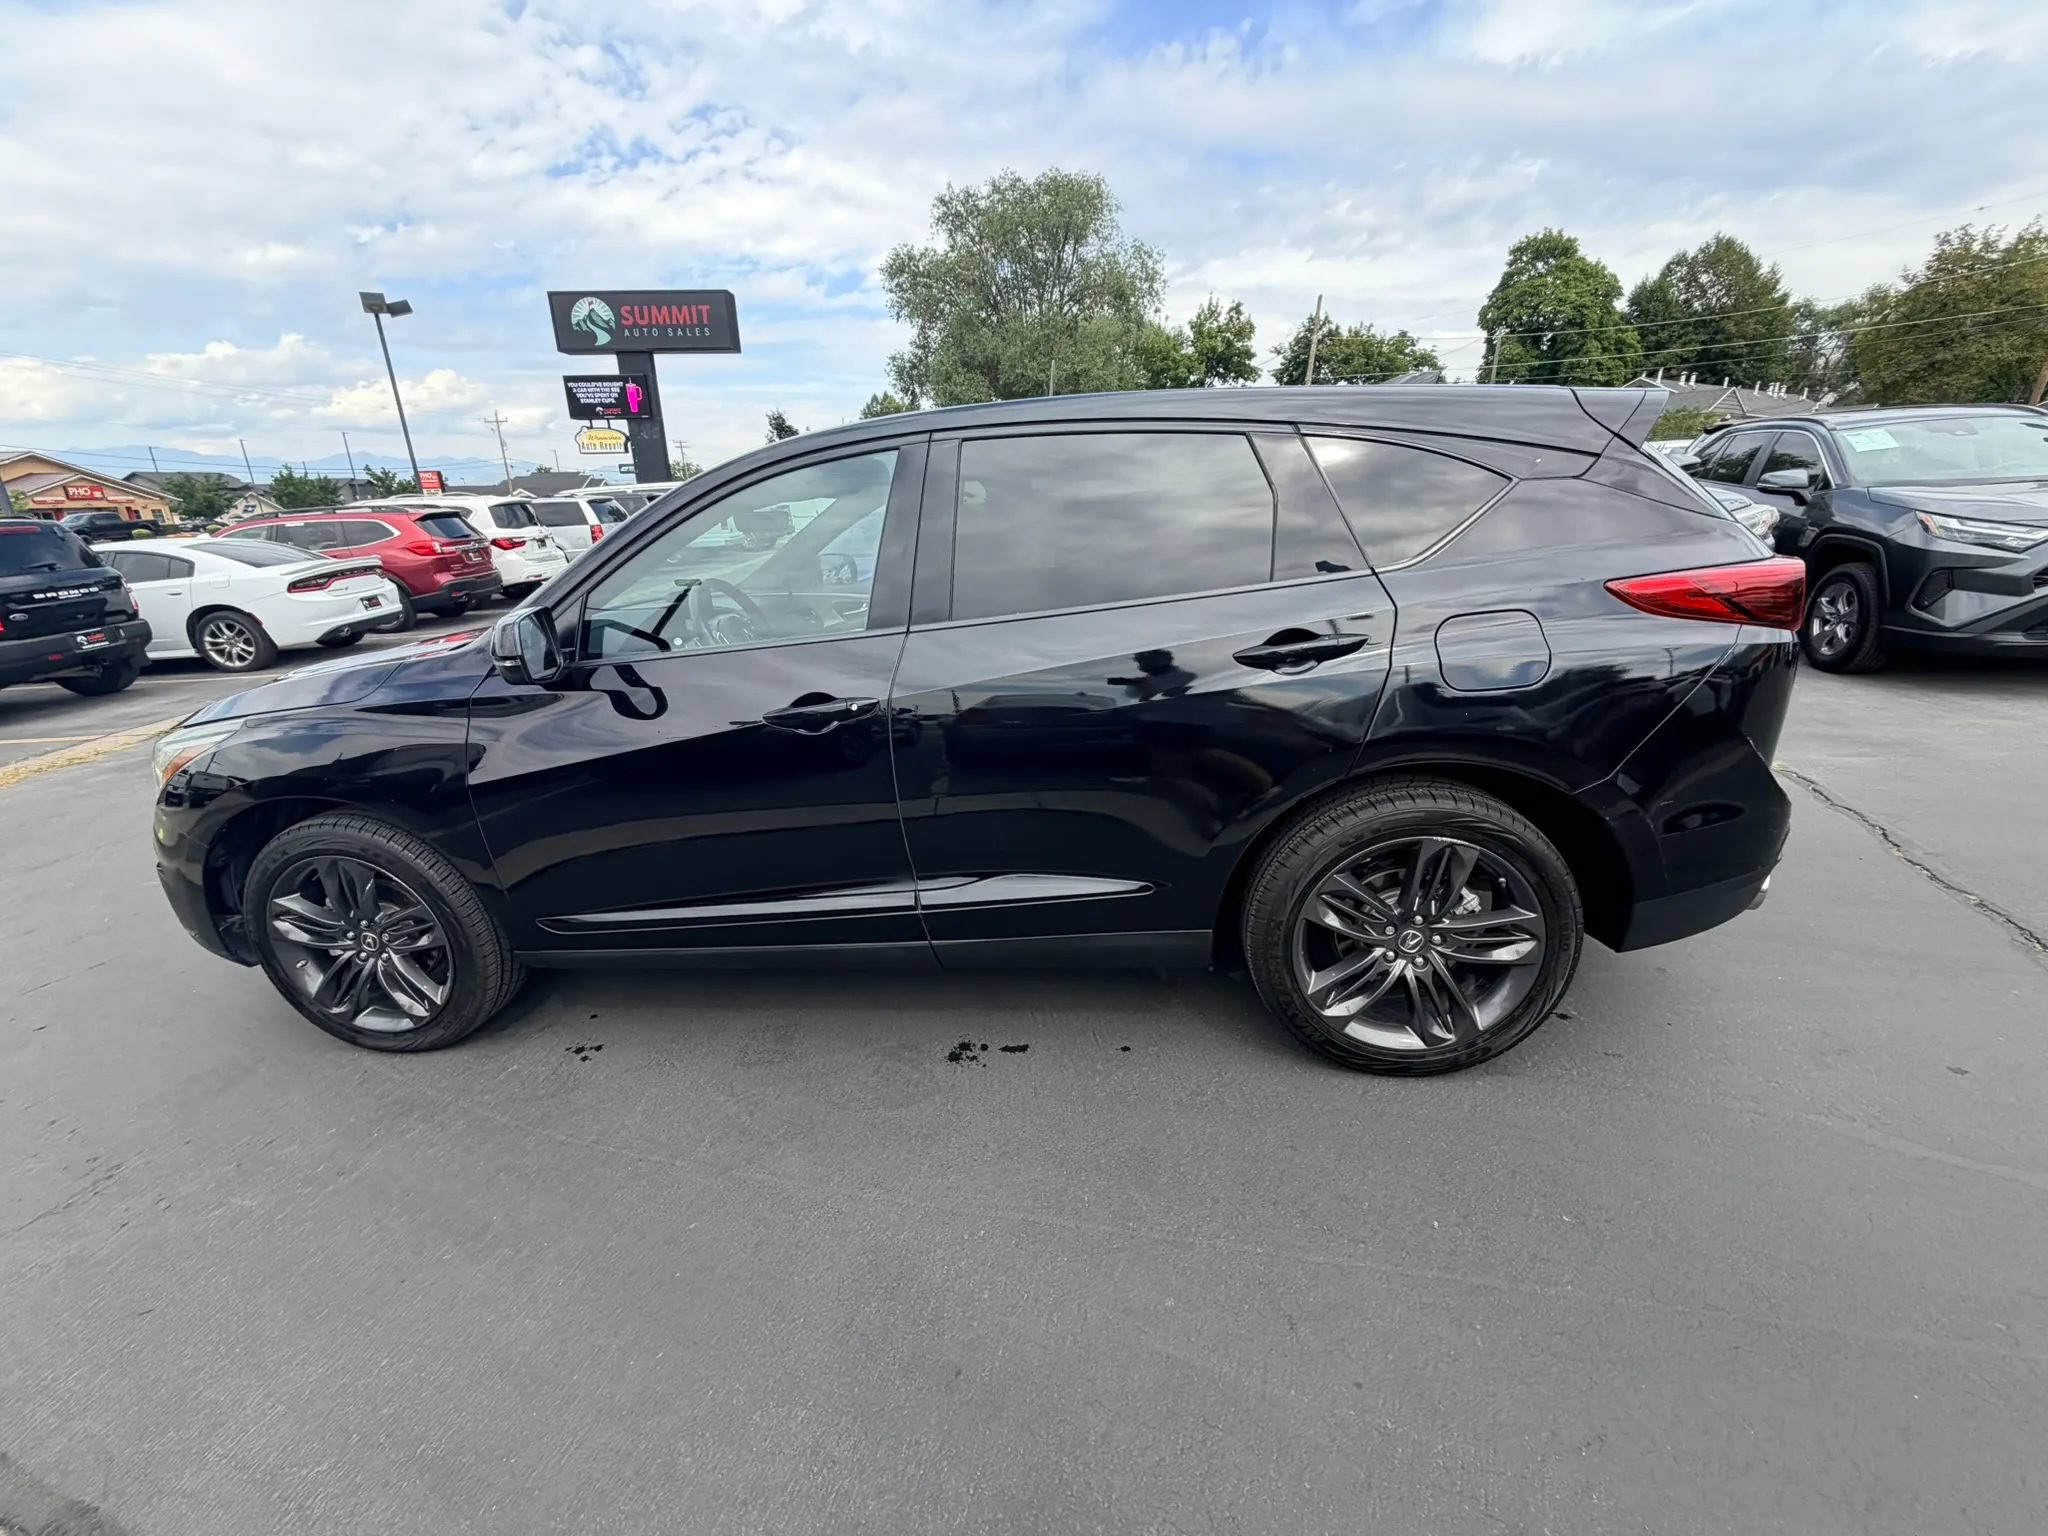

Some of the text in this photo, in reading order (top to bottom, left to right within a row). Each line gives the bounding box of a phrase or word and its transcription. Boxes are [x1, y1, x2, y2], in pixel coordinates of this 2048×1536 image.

[620, 305, 711, 326] SUMMIT
[624, 327, 710, 337] AUTO SALES
[582, 441, 623, 451] Auto Repair
[32, 586, 99, 600] BRONCO
